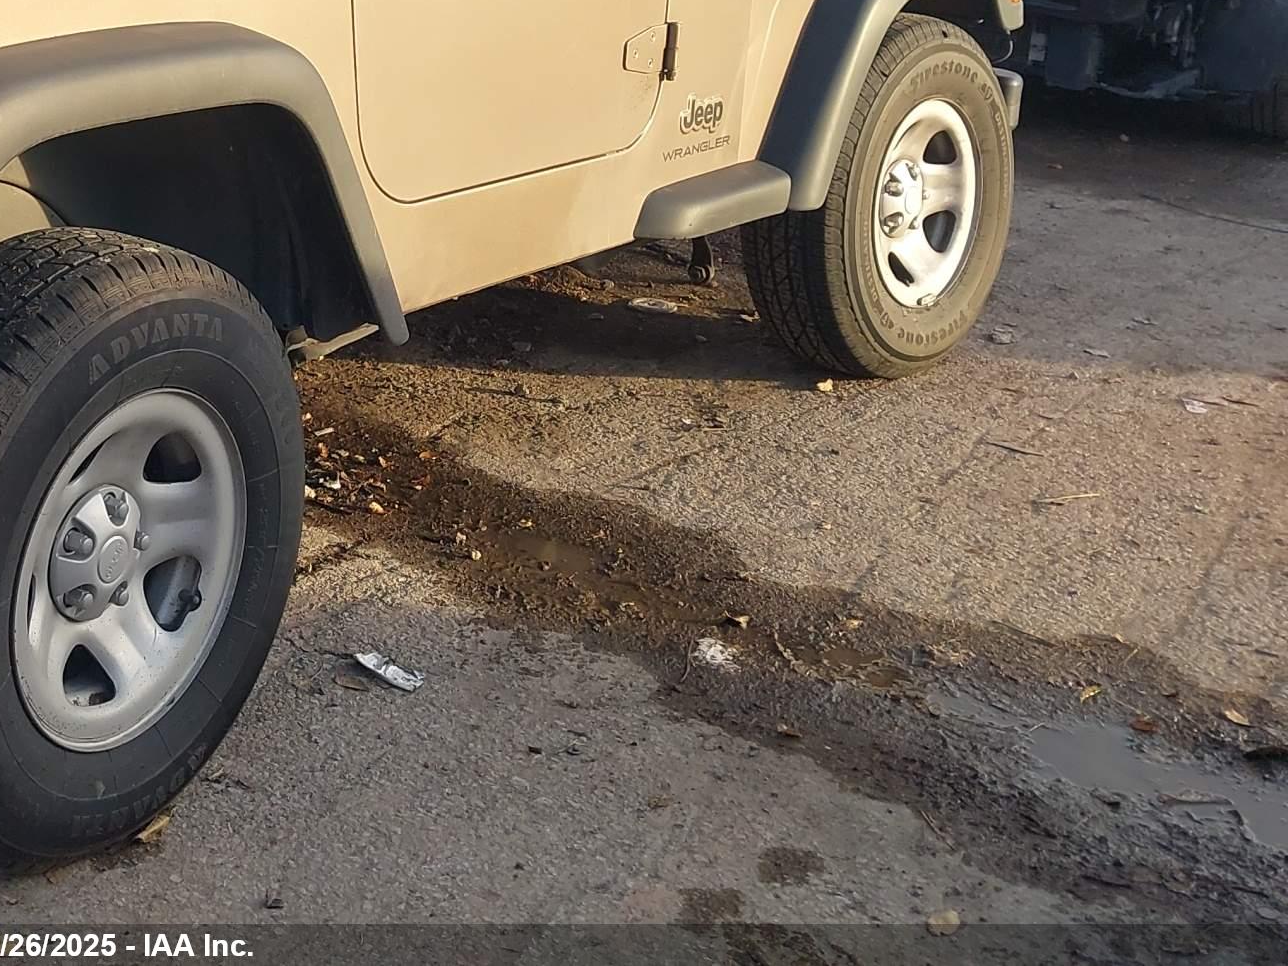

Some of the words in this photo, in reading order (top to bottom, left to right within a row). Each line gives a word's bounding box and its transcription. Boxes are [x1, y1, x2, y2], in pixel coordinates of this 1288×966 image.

[680, 93, 723, 134] Jeep
[663, 135, 730, 162] WRANGLER
[88, 313, 224, 385] ADVANTA
